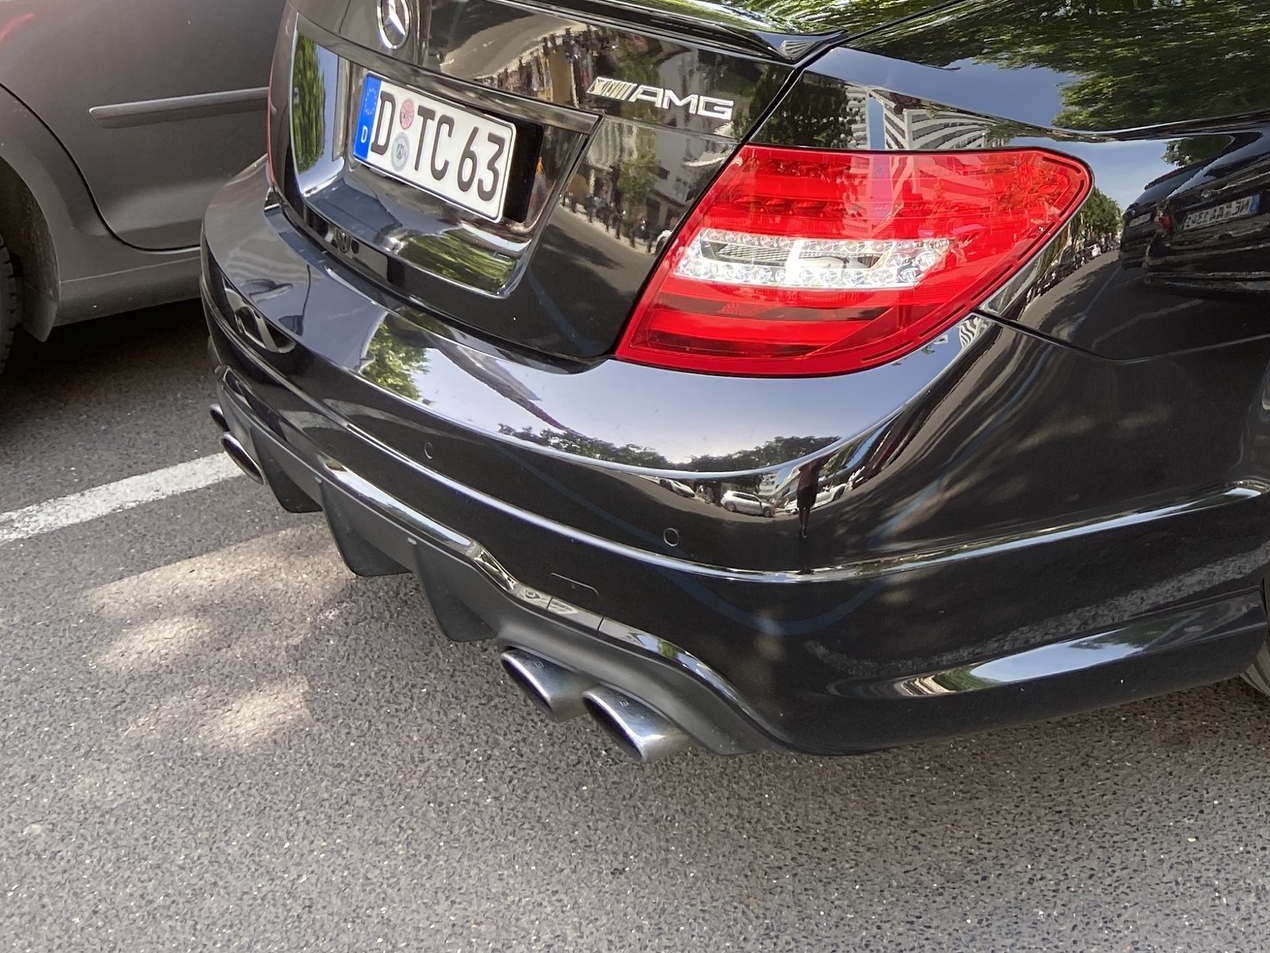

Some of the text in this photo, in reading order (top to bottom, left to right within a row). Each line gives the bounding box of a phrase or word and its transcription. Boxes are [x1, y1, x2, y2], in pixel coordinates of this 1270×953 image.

[629, 84, 735, 121] AMG
[361, 125, 369, 144] D
[371, 90, 506, 202] D TC 63
